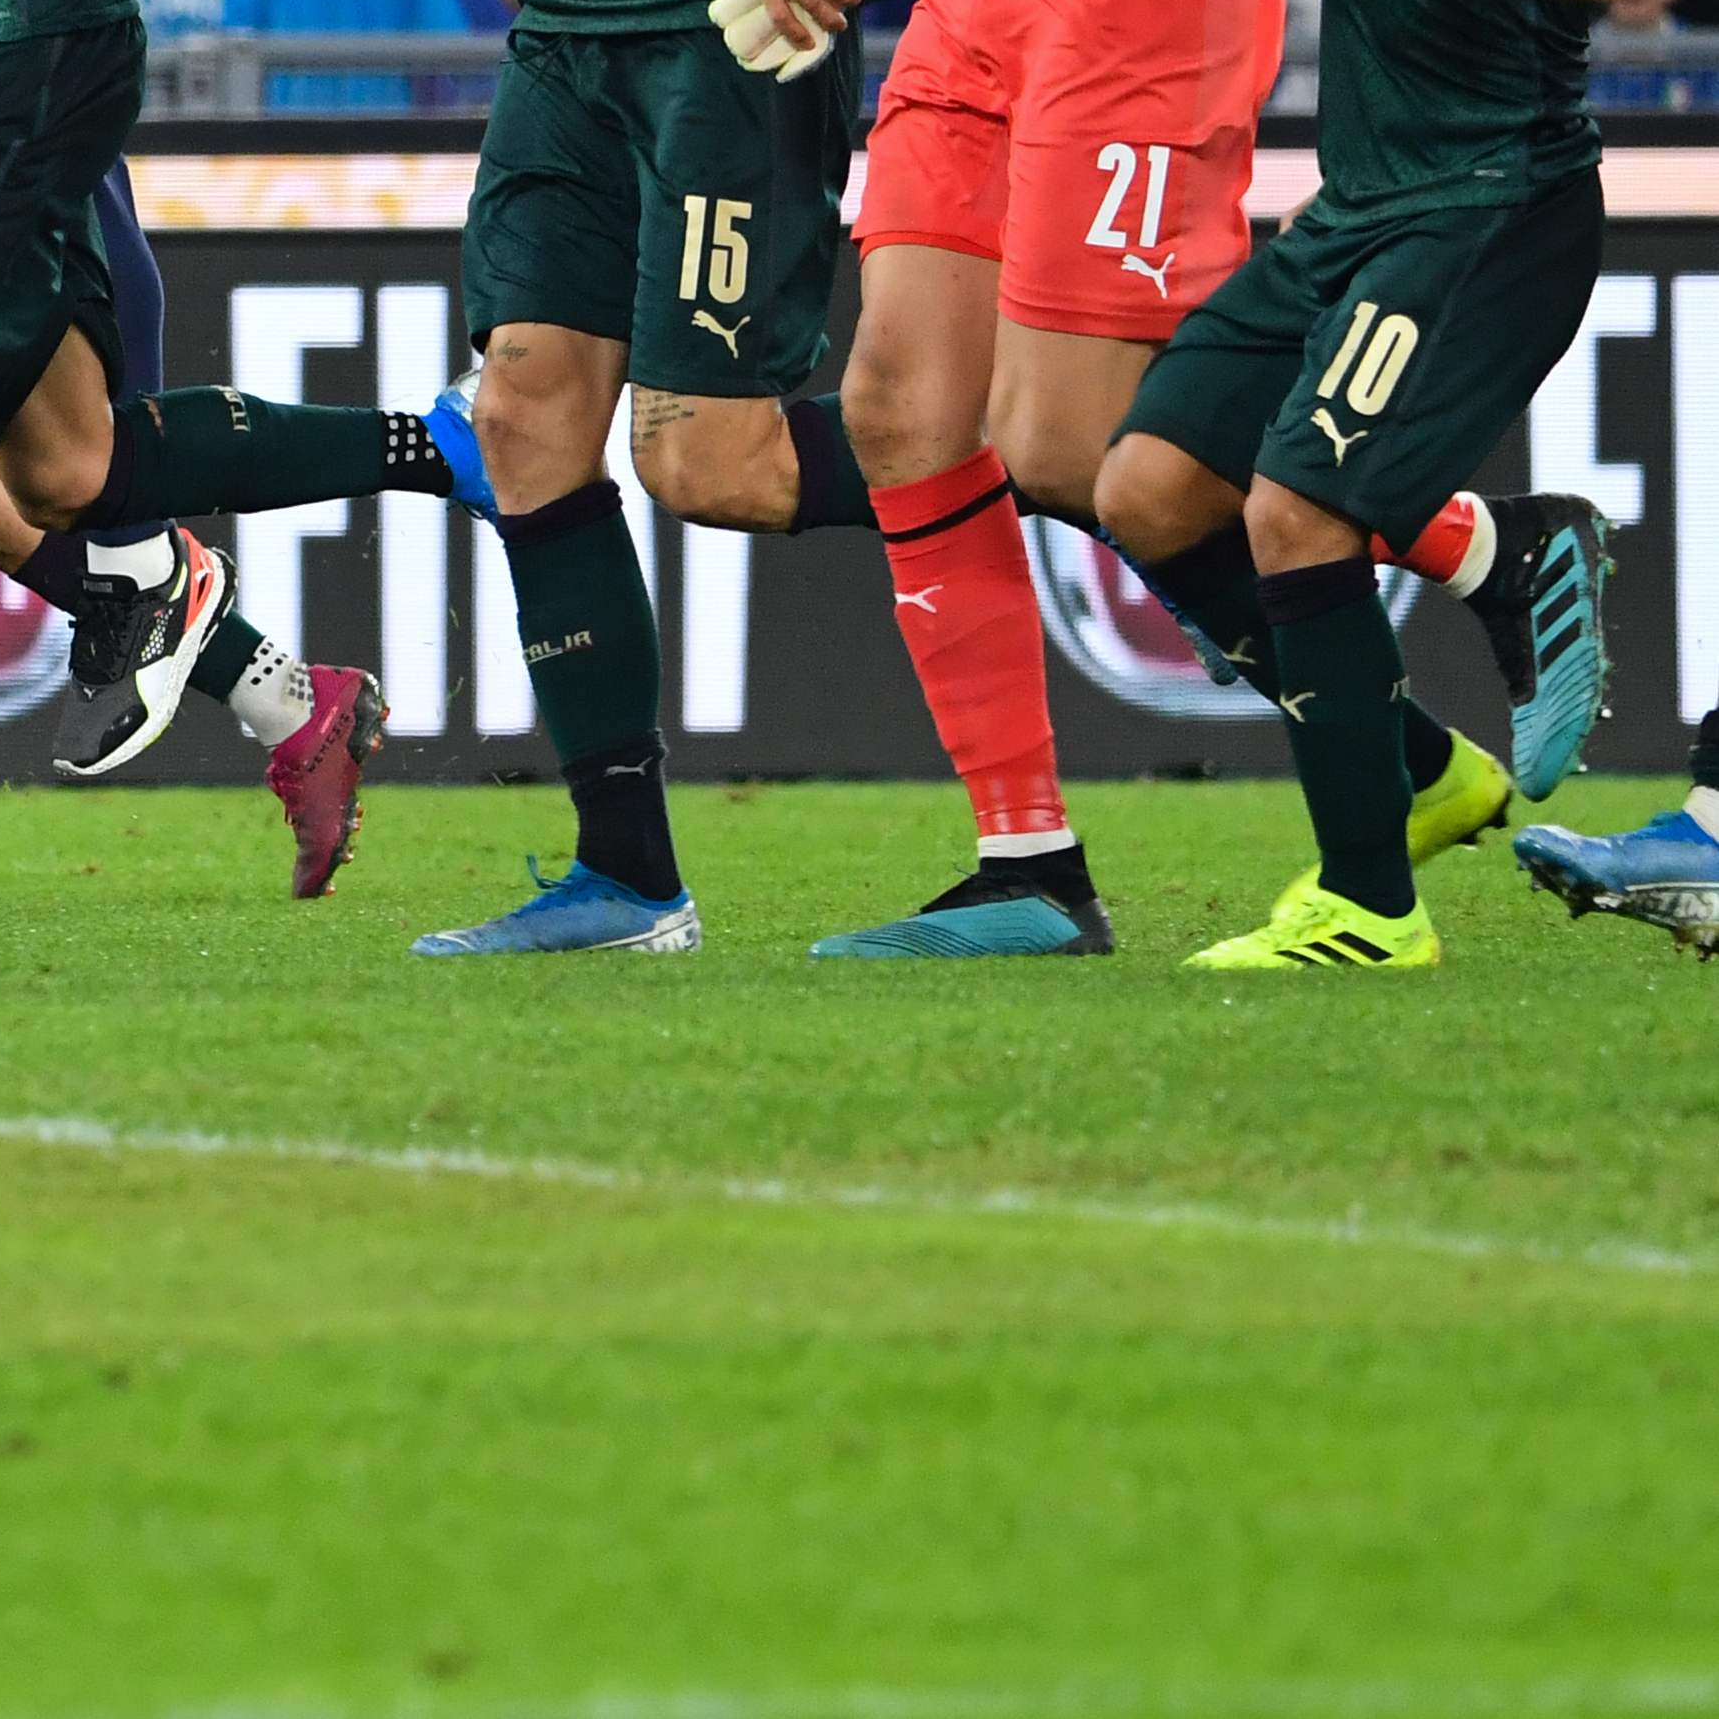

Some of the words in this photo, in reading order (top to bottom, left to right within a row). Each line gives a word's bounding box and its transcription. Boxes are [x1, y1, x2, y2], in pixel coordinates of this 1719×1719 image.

[677, 194, 754, 305] 15
[1084, 142, 1172, 250] 21
[1315, 300, 1420, 417] 10
